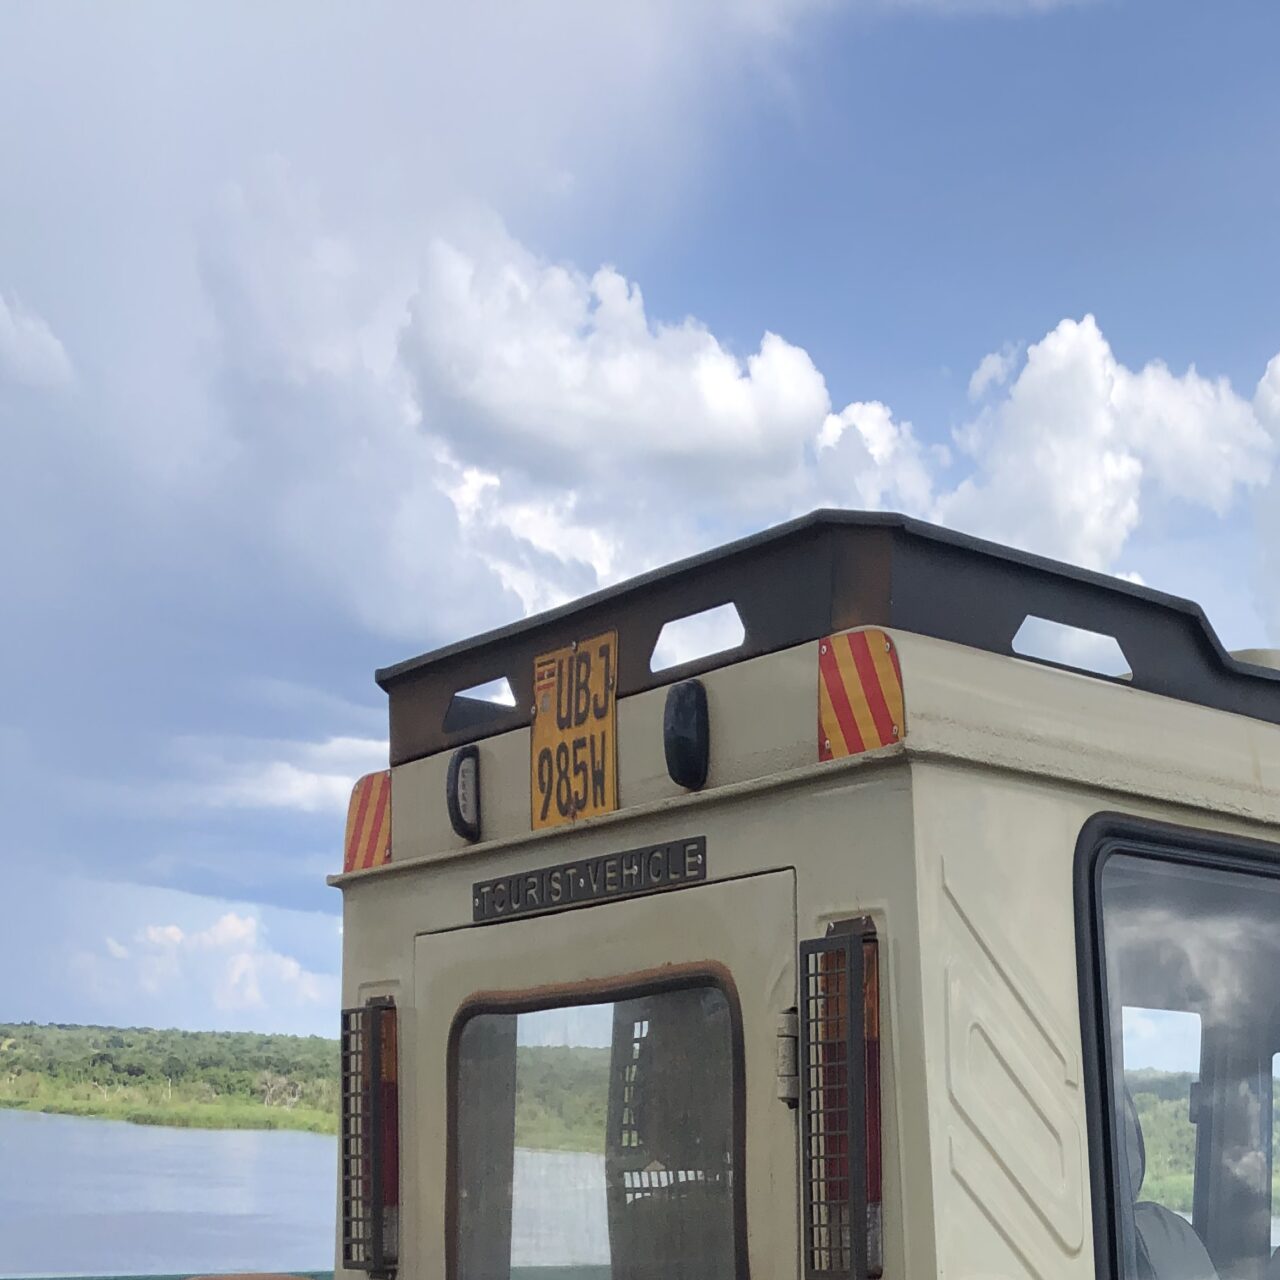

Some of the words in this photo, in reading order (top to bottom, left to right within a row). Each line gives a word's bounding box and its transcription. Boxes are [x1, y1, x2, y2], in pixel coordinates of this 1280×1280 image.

[556, 644, 611, 730] UBJ
[537, 731, 606, 822] 985W
[480, 867, 577, 915] TOURIST
[588, 844, 698, 892] VEHICLE
